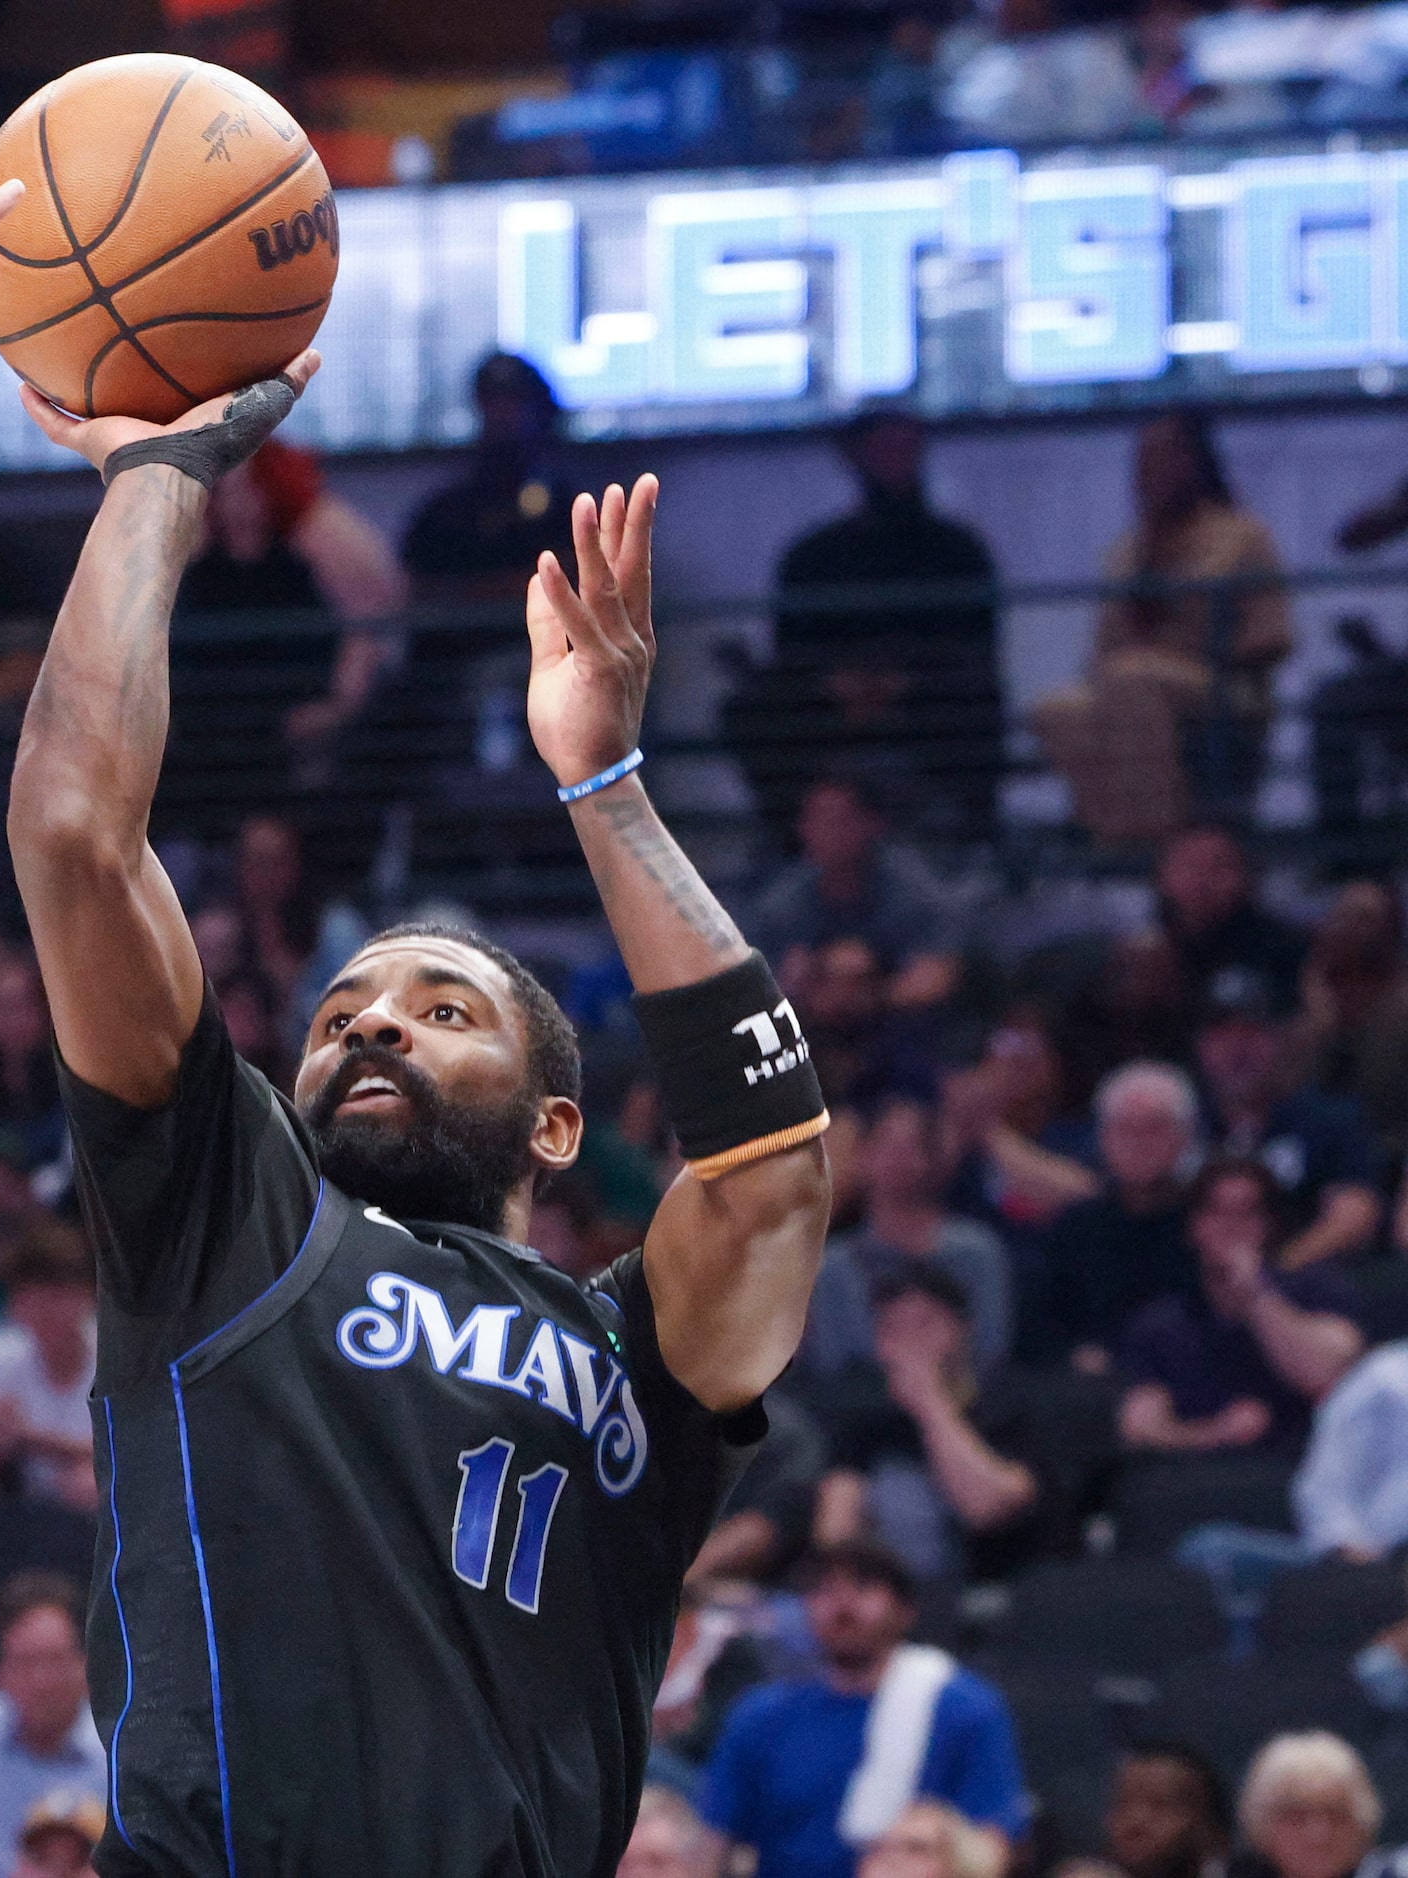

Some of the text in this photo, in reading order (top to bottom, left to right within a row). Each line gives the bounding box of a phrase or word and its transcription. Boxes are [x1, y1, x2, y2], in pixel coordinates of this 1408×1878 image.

[498, 149, 1408, 408] LET'S G
[731, 998, 802, 1057] 11
[336, 1271, 648, 1498] MAVS
[452, 1436, 569, 1616] 11
